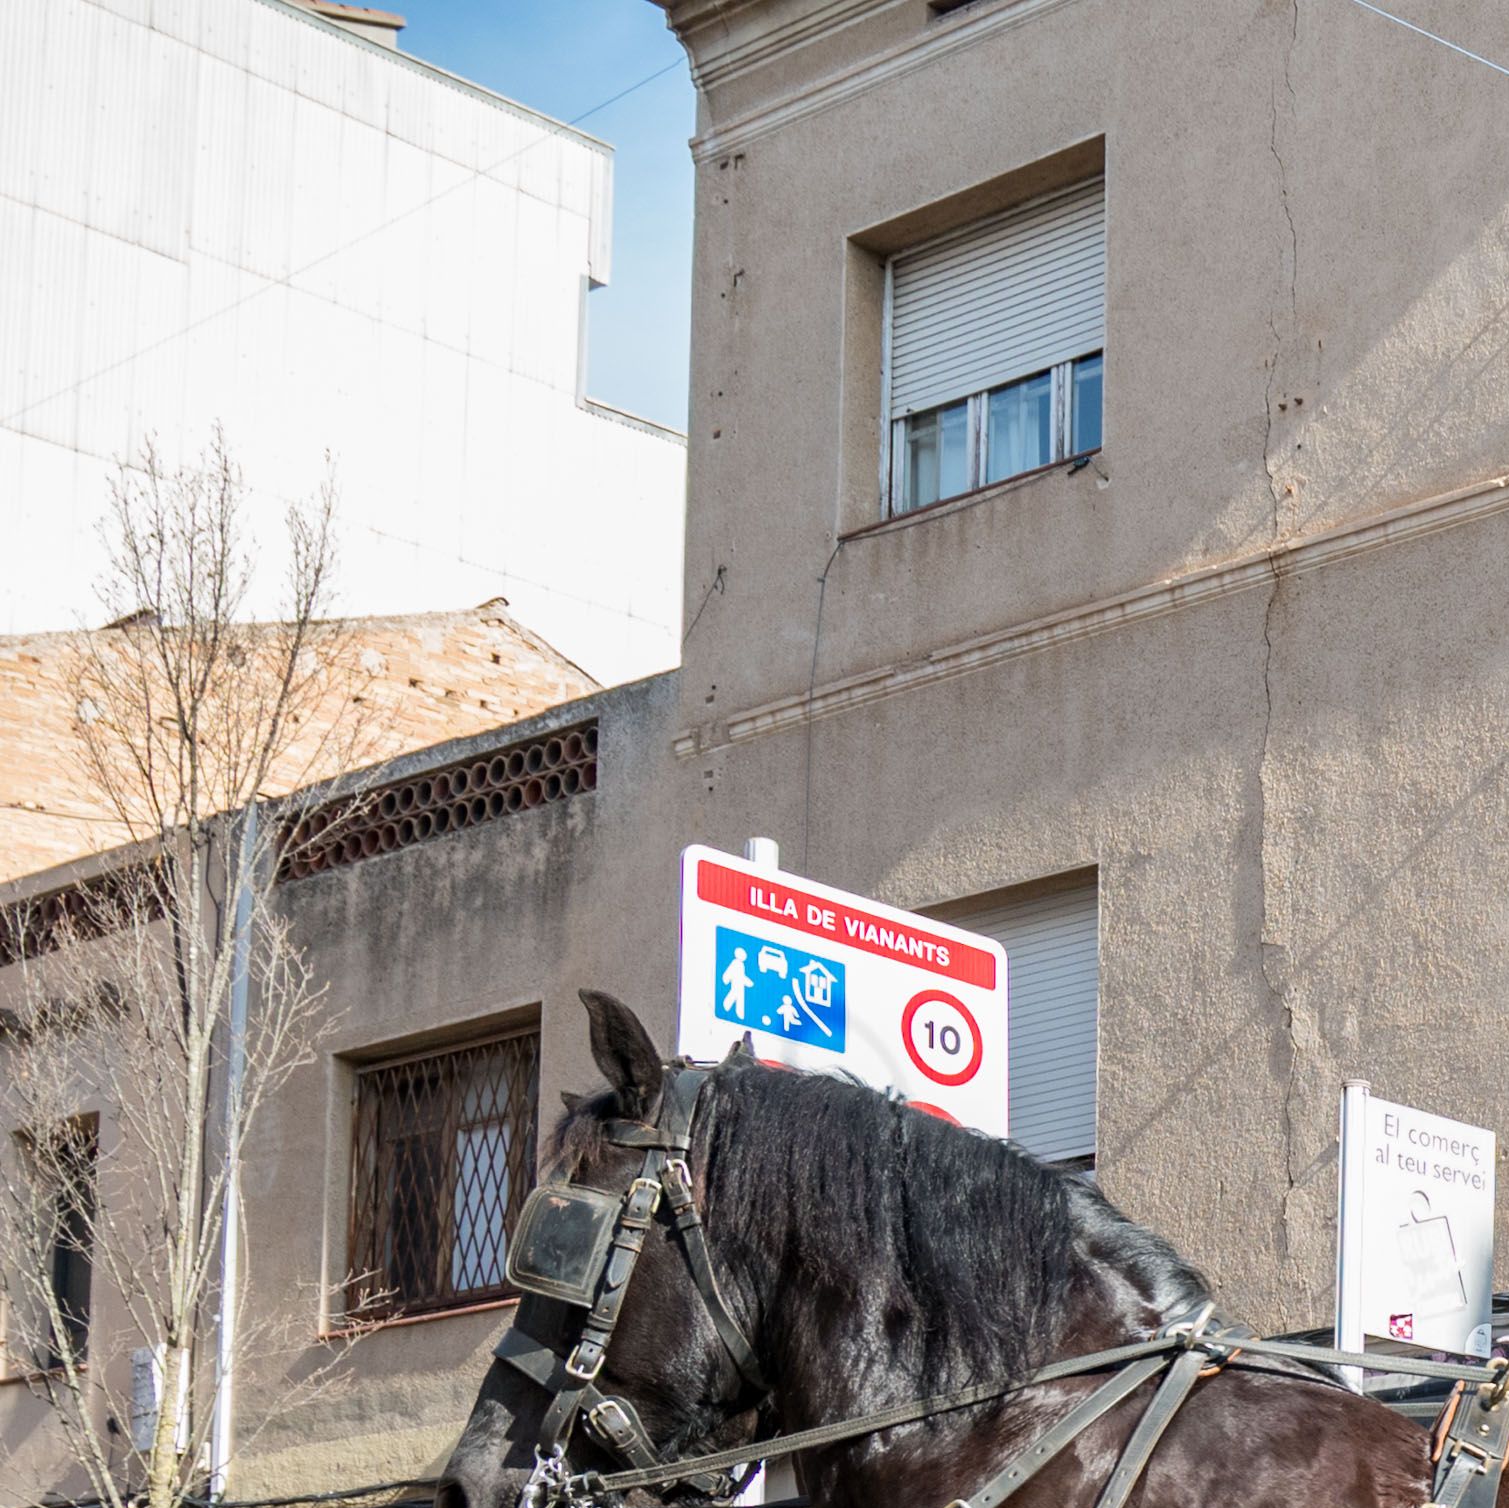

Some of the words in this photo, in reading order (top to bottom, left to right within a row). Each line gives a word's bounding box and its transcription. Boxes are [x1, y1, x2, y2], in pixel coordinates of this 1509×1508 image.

[750, 886, 798, 919] ILLA
[806, 903, 836, 931] DE
[844, 916, 951, 967] VIANANTS
[924, 1019, 962, 1056] 10
[1384, 1113, 1400, 1139] El
[1408, 1128, 1480, 1166] comerç
[1375, 1143, 1390, 1166] al
[1397, 1152, 1427, 1176] teu
[1432, 1163, 1486, 1192] servei
